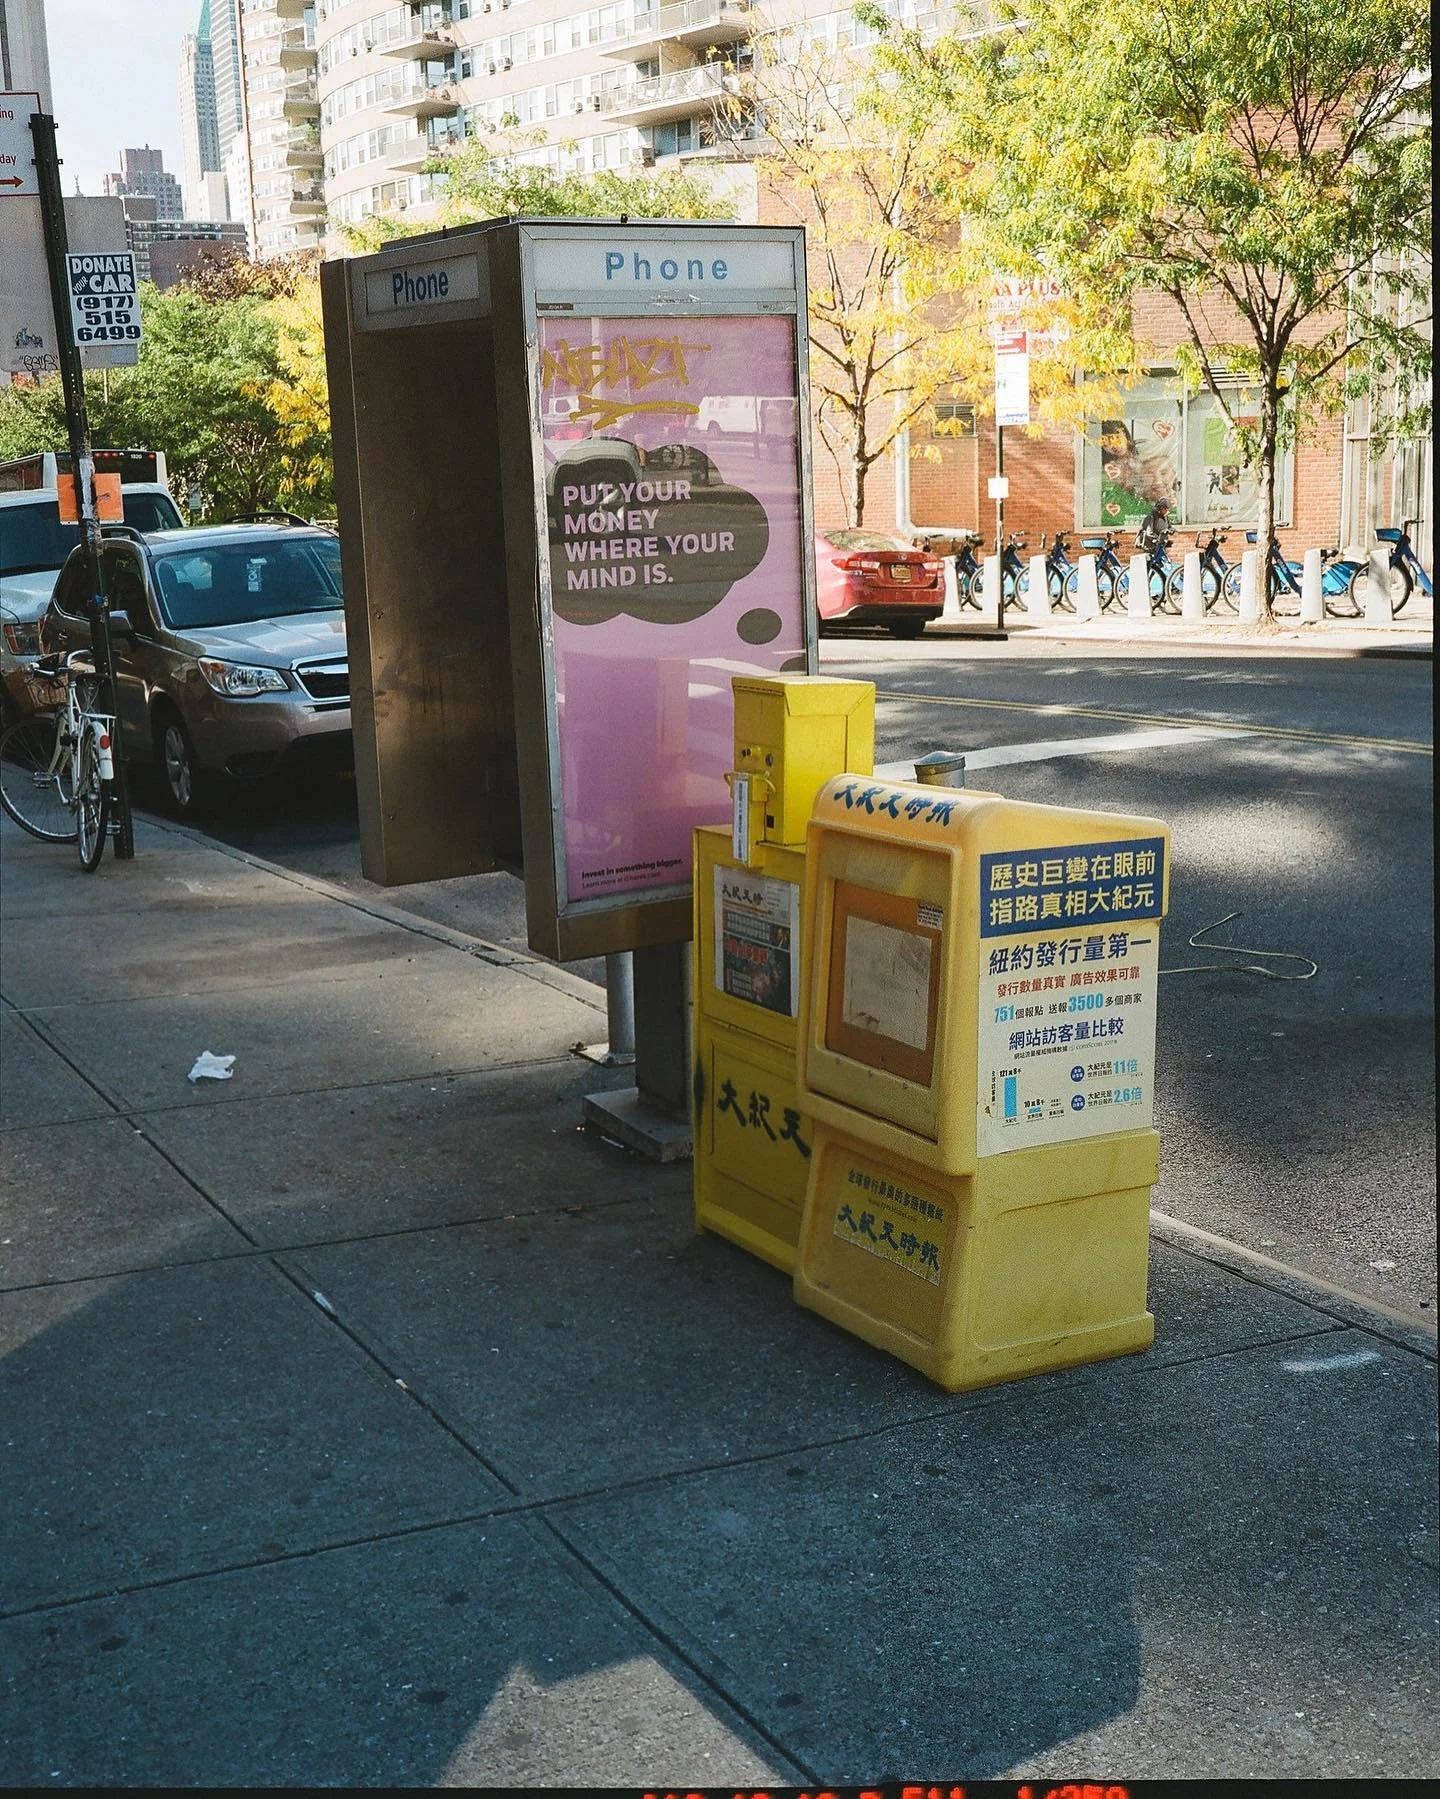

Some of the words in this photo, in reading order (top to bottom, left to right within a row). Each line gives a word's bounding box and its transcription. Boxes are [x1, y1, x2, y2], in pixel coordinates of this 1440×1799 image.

[71, 256, 131, 274] DONATE
[605, 251, 729, 281] Phone
[72, 276, 89, 294] YOUR
[89, 274, 134, 293] CAR
[392, 271, 449, 304] Phone
[76, 295, 134, 311] (917)
[85, 310, 131, 326] 515
[77, 325, 141, 341] 6499
[562, 484, 614, 506] PUT
[619, 480, 691, 503] YOUR
[564, 509, 659, 535] MONEY
[564, 536, 659, 562] WHERE
[664, 532, 735, 555] YOUR
[567, 565, 637, 591] MIND
[643, 563, 674, 585] IS.
[582, 869, 605, 879] Invest
[606, 867, 615, 876] in
[615, 861, 656, 873] something
[989, 850, 1156, 892] 歷史巨變在眼前
[989, 882, 1155, 926] 指路真相大紀元
[989, 932, 1152, 976] 紐約發行量第一
[997, 975, 1066, 998] 發行數量真實
[1070, 966, 1141, 985] 廣告效果可靠
[1009, 1017, 1124, 1050] 網站訪客量比較
